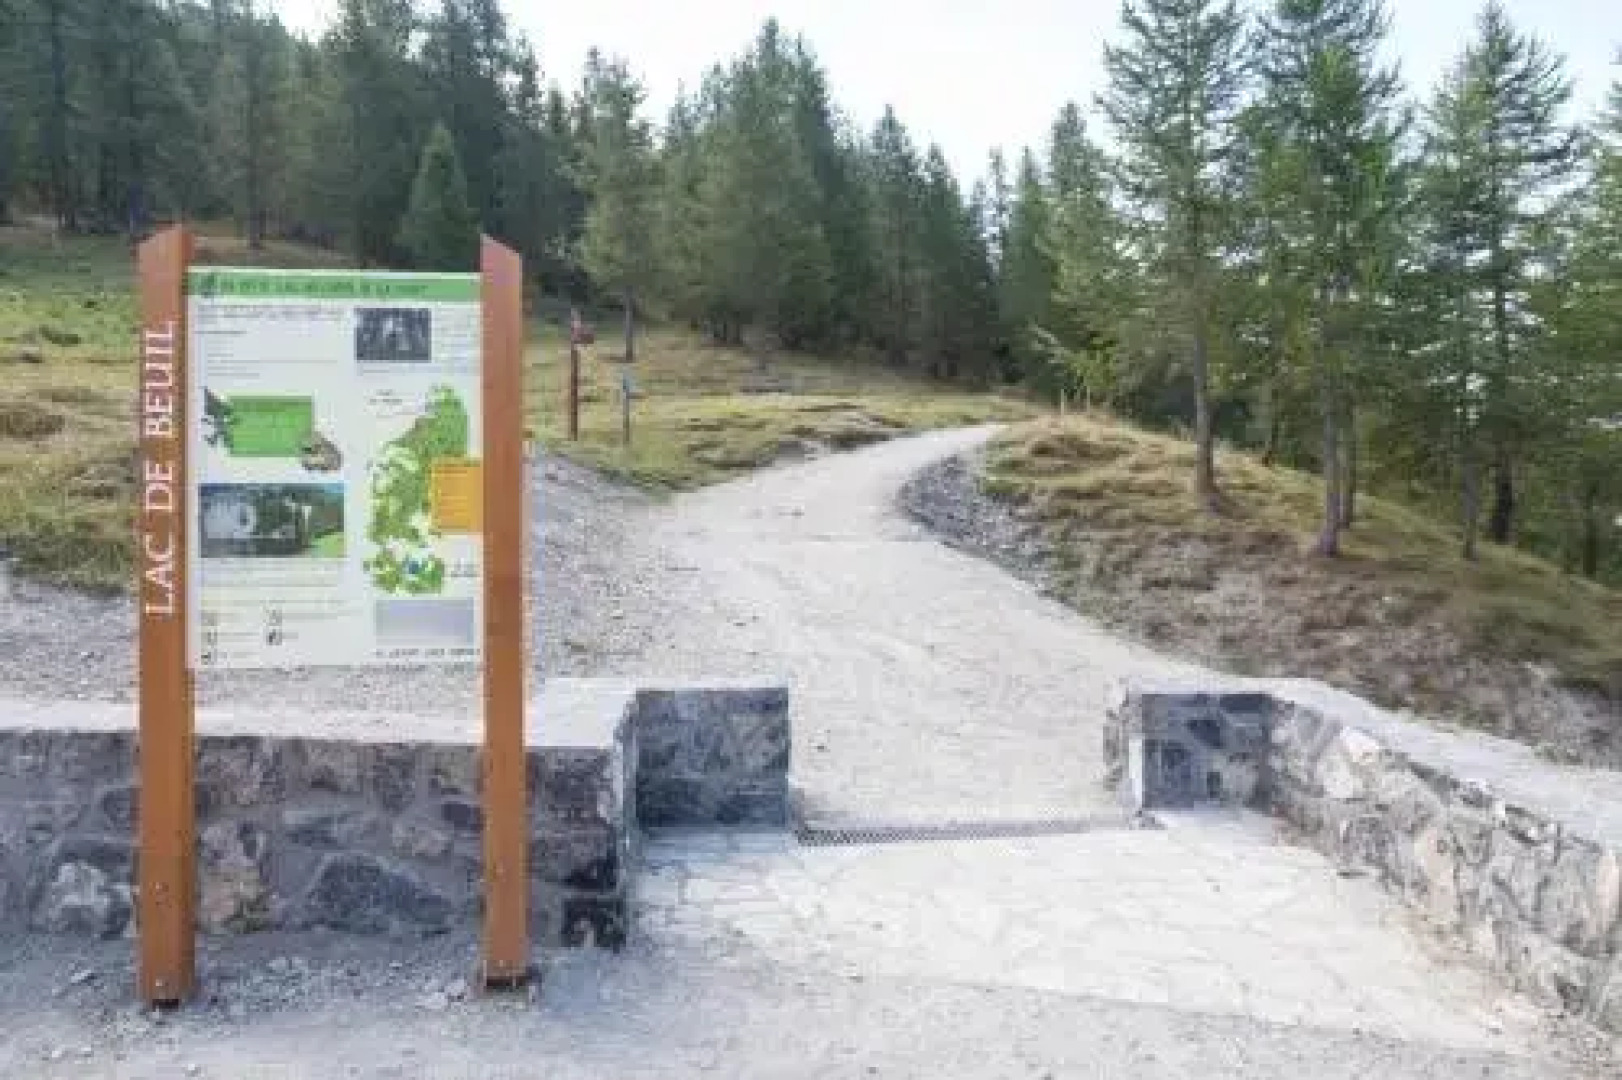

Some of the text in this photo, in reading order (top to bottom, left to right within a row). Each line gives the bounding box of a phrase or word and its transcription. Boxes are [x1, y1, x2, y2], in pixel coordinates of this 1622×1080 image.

[145, 320, 173, 614] LAC DE BEUIL
